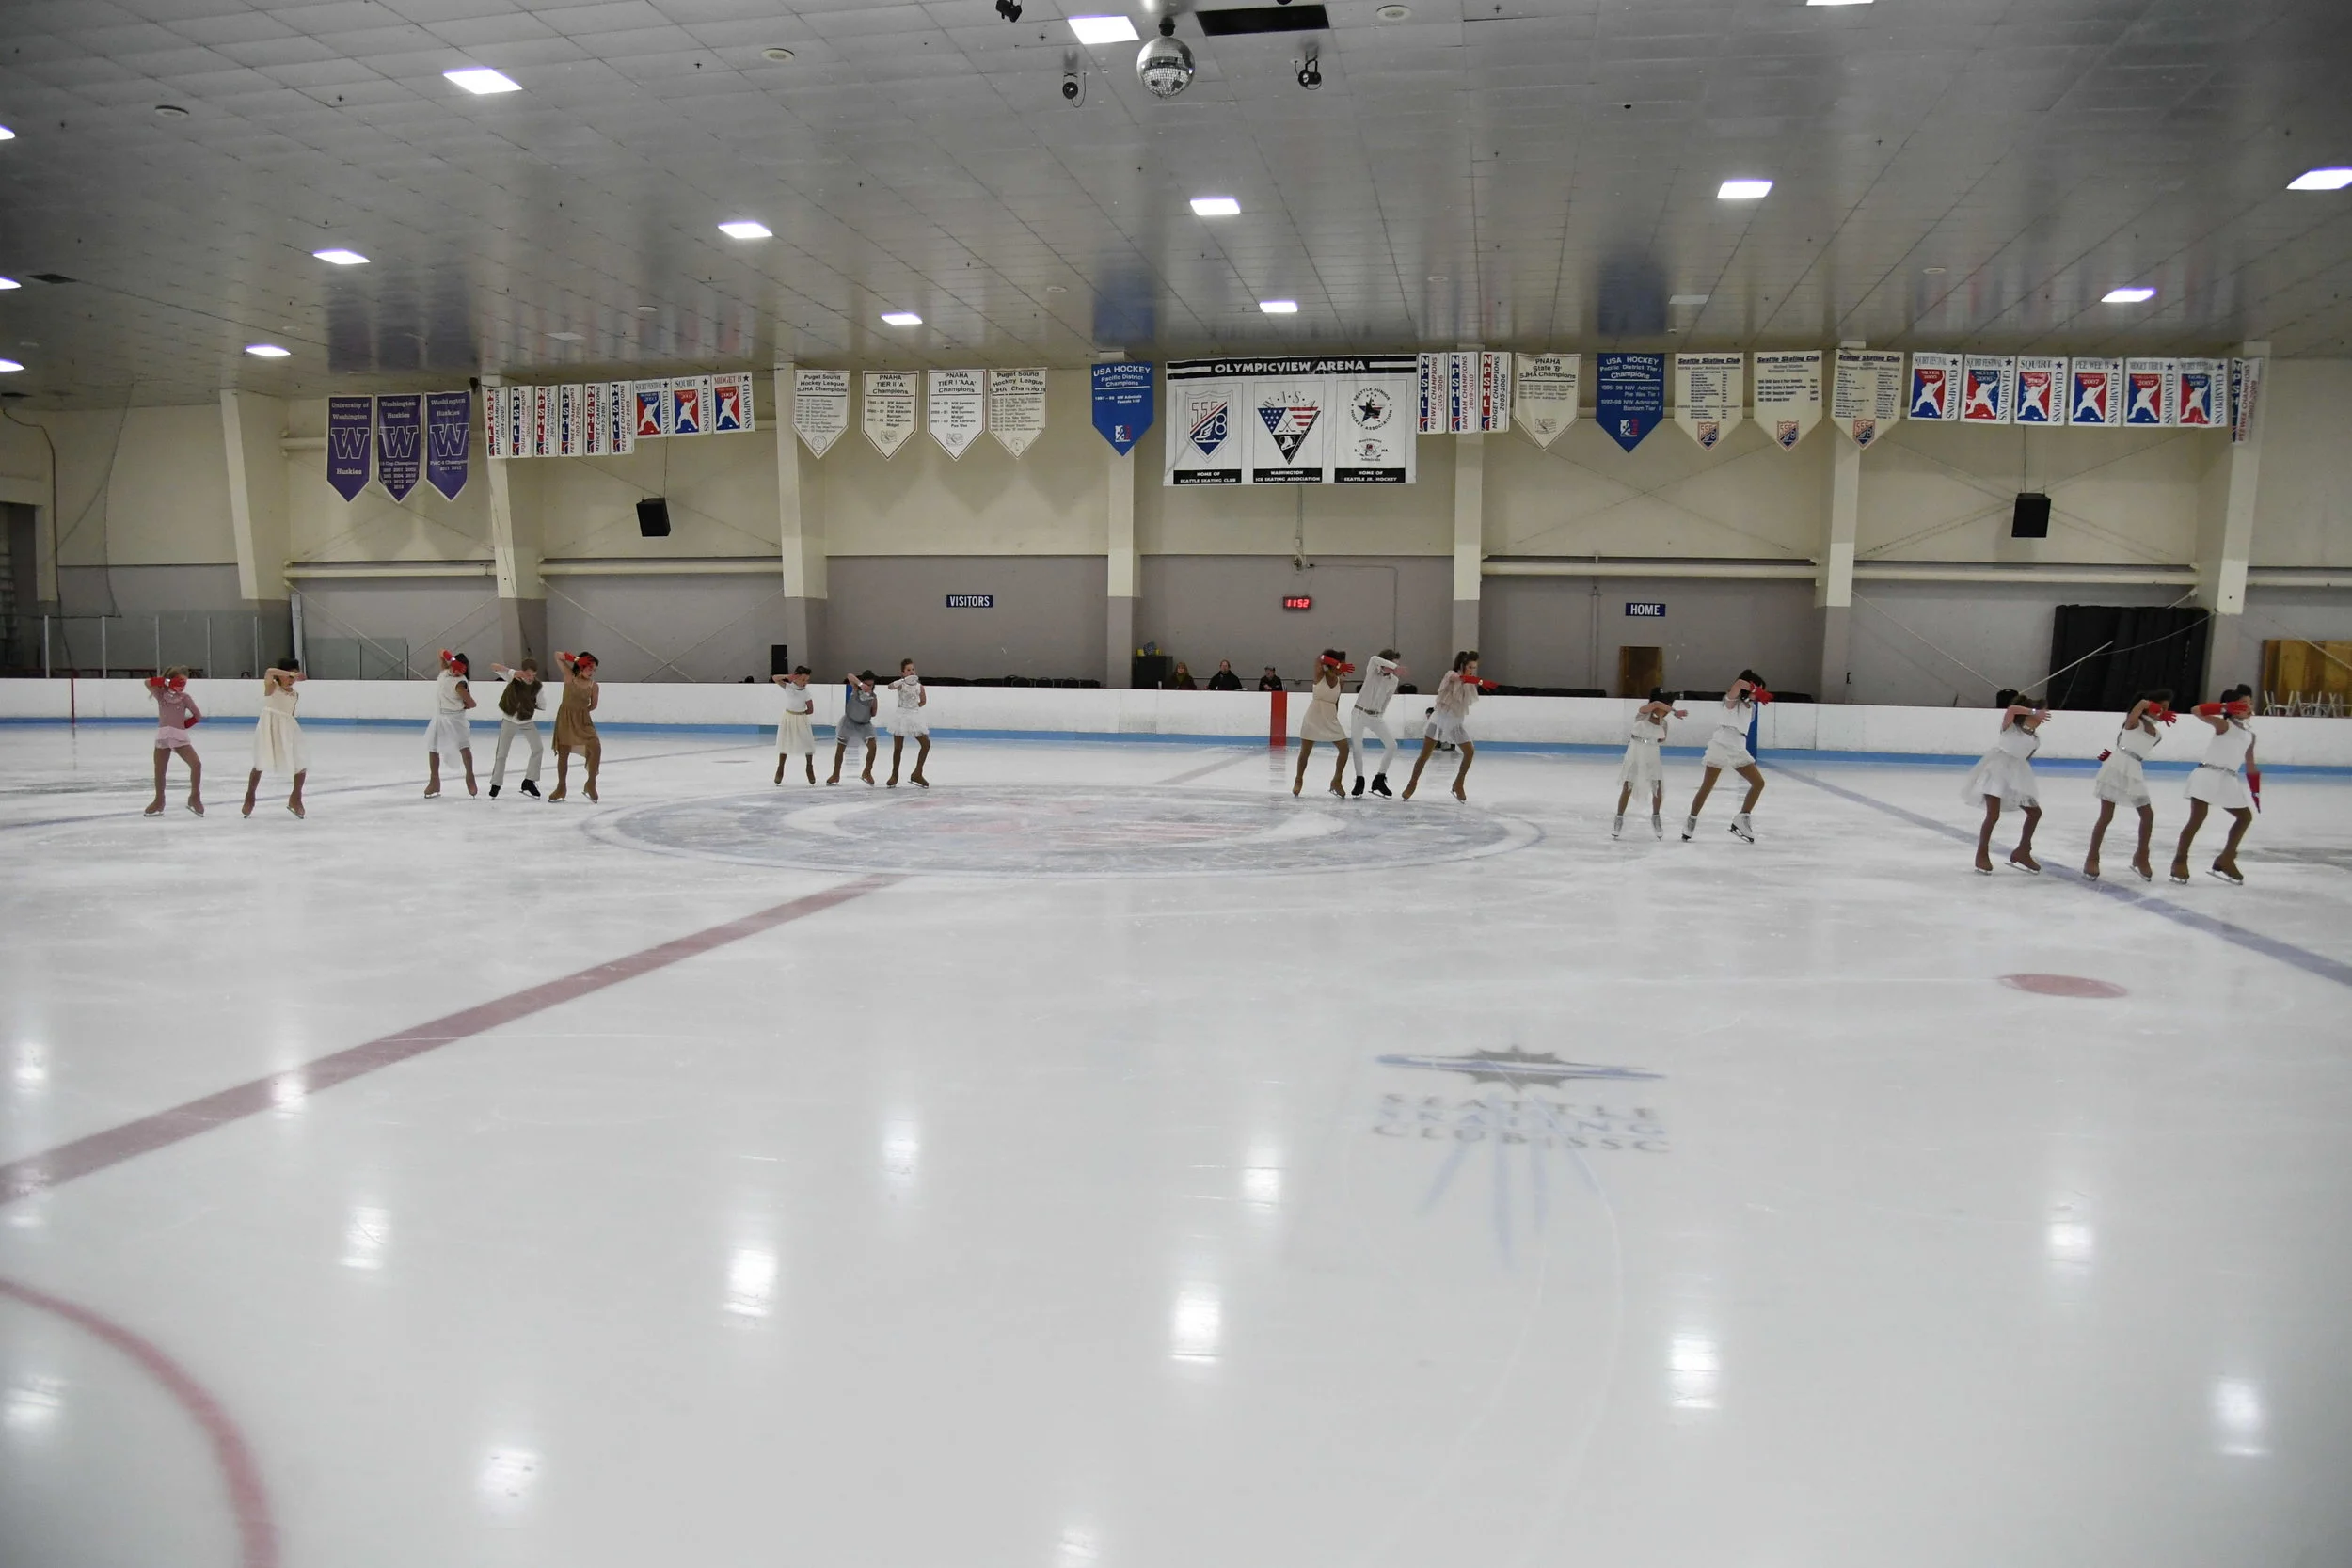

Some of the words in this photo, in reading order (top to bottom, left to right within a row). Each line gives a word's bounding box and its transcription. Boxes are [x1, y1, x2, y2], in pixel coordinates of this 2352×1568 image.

[1094, 367, 1111, 377] USA
[1114, 365, 1150, 374] HOCKEY
[1215, 362, 1311, 373] OLYMPICVIEW
[1316, 361, 1366, 370] ARENA
[1627, 356, 1659, 365] HOCKEY
[2021, 360, 2052, 369] SQUIRT
[2075, 361, 2087, 369] PEE
[2088, 361, 2103, 369] WEE
[676, 379, 696, 389] SQUIRT
[993, 378, 1016, 387] Hockey
[1353, 388, 1372, 401] SEATTLE
[1374, 388, 1390, 401] JUNIOR
[1947, 369, 1957, 419] CHAMPIONS
[1999, 370, 2011, 421] CHAMPIONS
[2053, 372, 2063, 423] CHAMPIONS
[2109, 373, 2119, 424] CHAMPIONS
[2164, 374, 2174, 424] CHAMPIONS
[2215, 374, 2225, 424] CHAMPIONS
[742, 384, 752, 429] CHAMPIONS
[1214, 413, 1226, 435] 8
[331, 428, 369, 459] W
[379, 425, 418, 458] W
[430, 423, 469, 456] W
[950, 596, 990, 606] VISITORS
[1631, 604, 1660, 615] HOME
